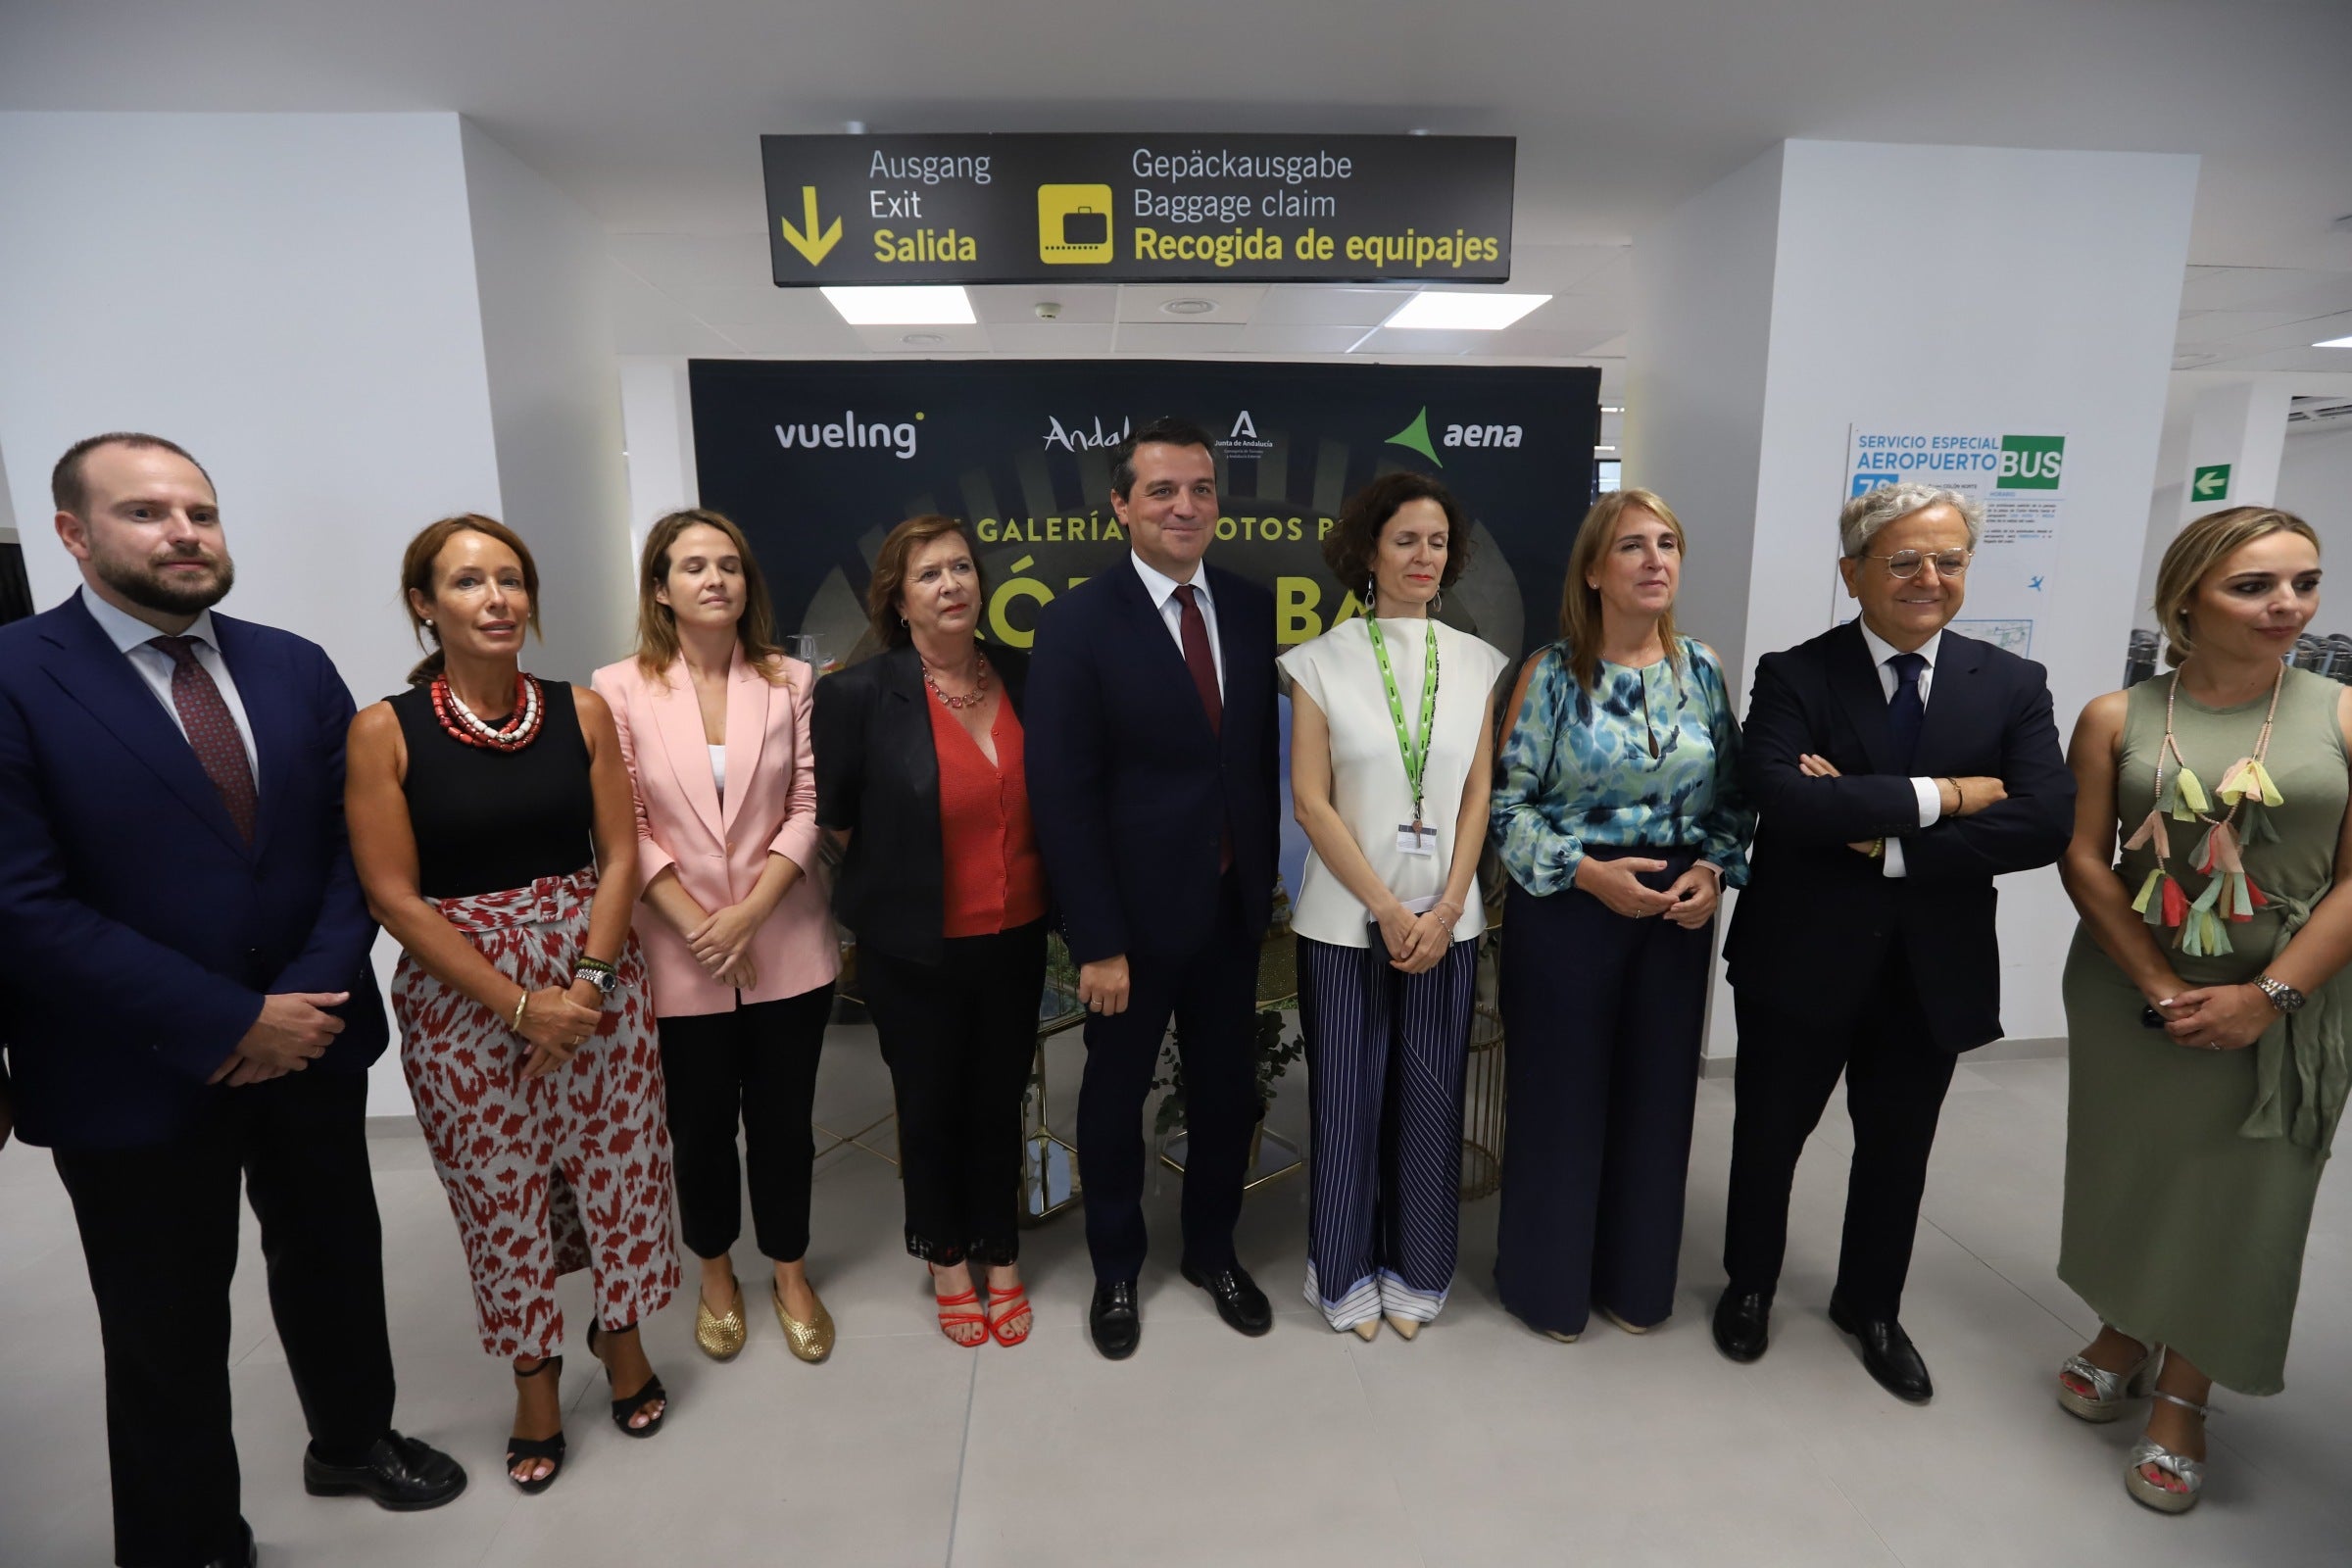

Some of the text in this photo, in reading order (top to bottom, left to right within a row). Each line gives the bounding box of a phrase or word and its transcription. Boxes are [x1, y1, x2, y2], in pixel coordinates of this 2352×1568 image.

[869, 149, 992, 184] Ausgang
[1132, 148, 1352, 184] Gepäckausgabe
[869, 189, 923, 219] Exit
[1134, 188, 1336, 223] Baggage claim
[873, 228, 977, 263] Salida
[1134, 226, 1499, 269] Recogida de equipajes
[774, 410, 924, 459] vueling
[1042, 415, 1130, 453] Andal
[1443, 423, 1523, 448] aena
[1858, 435, 2000, 451] SERVICIO ESPECIAL
[1857, 452, 1997, 471] AEROPUERTO
[1999, 450, 2062, 479] BUS
[976, 510, 1124, 542] GALERÍA
[1214, 516, 1302, 541] OTOS
